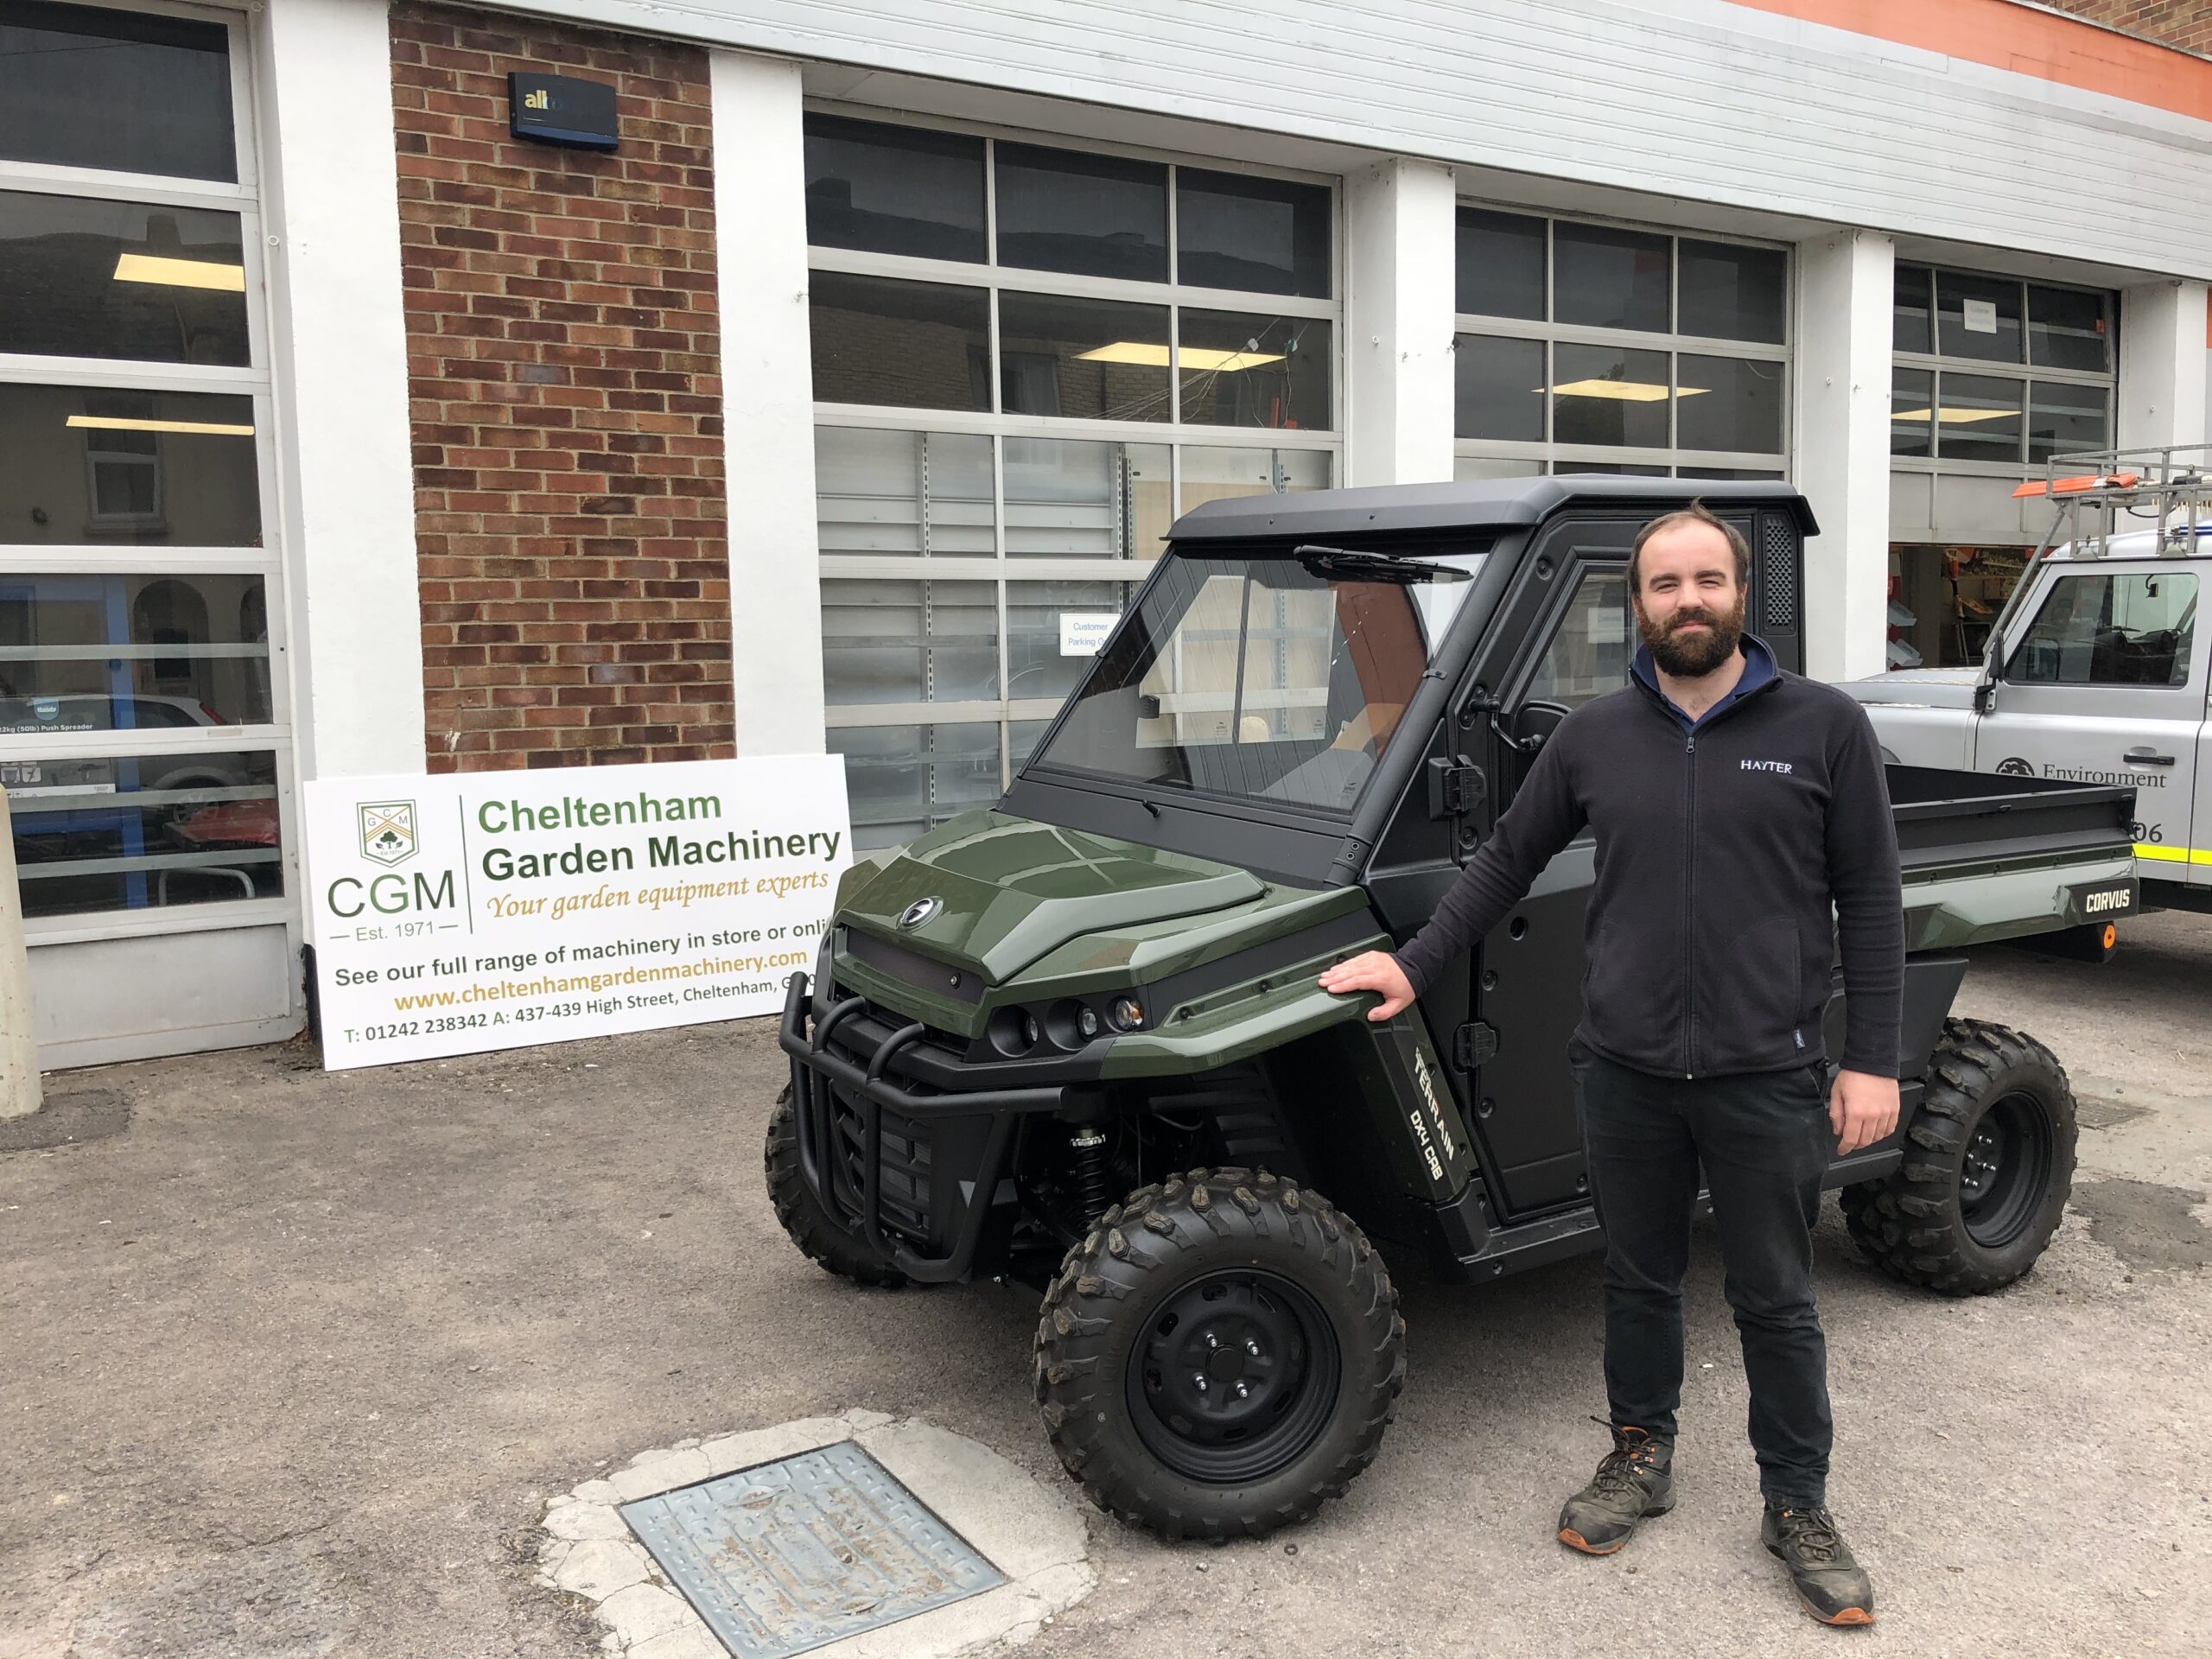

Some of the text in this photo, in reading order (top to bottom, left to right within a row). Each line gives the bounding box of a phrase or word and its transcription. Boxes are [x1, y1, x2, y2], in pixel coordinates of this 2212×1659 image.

[1068, 638, 1096, 647] Parking
[1073, 622, 1108, 631] Customer
[1740, 760, 1793, 775] HAYTER
[2043, 764, 2167, 788] Environment
[479, 791, 721, 834] Cheltenham
[482, 830, 841, 881] Garden Machinery
[327, 869, 456, 918] CGM
[486, 871, 830, 920] Your garden equipment experts
[2086, 888, 2131, 913] CORVUS
[335, 918, 826, 987] See our full range of machinery in store or onli
[356, 920, 433, 942] Est. 1971
[394, 950, 808, 1011] www.cheltenhamgardenmachinery.com
[344, 1028, 360, 1044] T:
[365, 1021, 420, 1041] 01242
[424, 1014, 488, 1033] 238342
[493, 1011, 511, 1026] A:
[515, 1002, 582, 1022] 437-439
[587, 996, 622, 1015] High
[627, 991, 679, 1009] Street,
[683, 980, 778, 1001] Cheltenham,
[1414, 1047, 1454, 1161] TERRAIN
[1410, 1109, 1431, 1147] DX4
[1424, 1145, 1444, 1181] CAB
